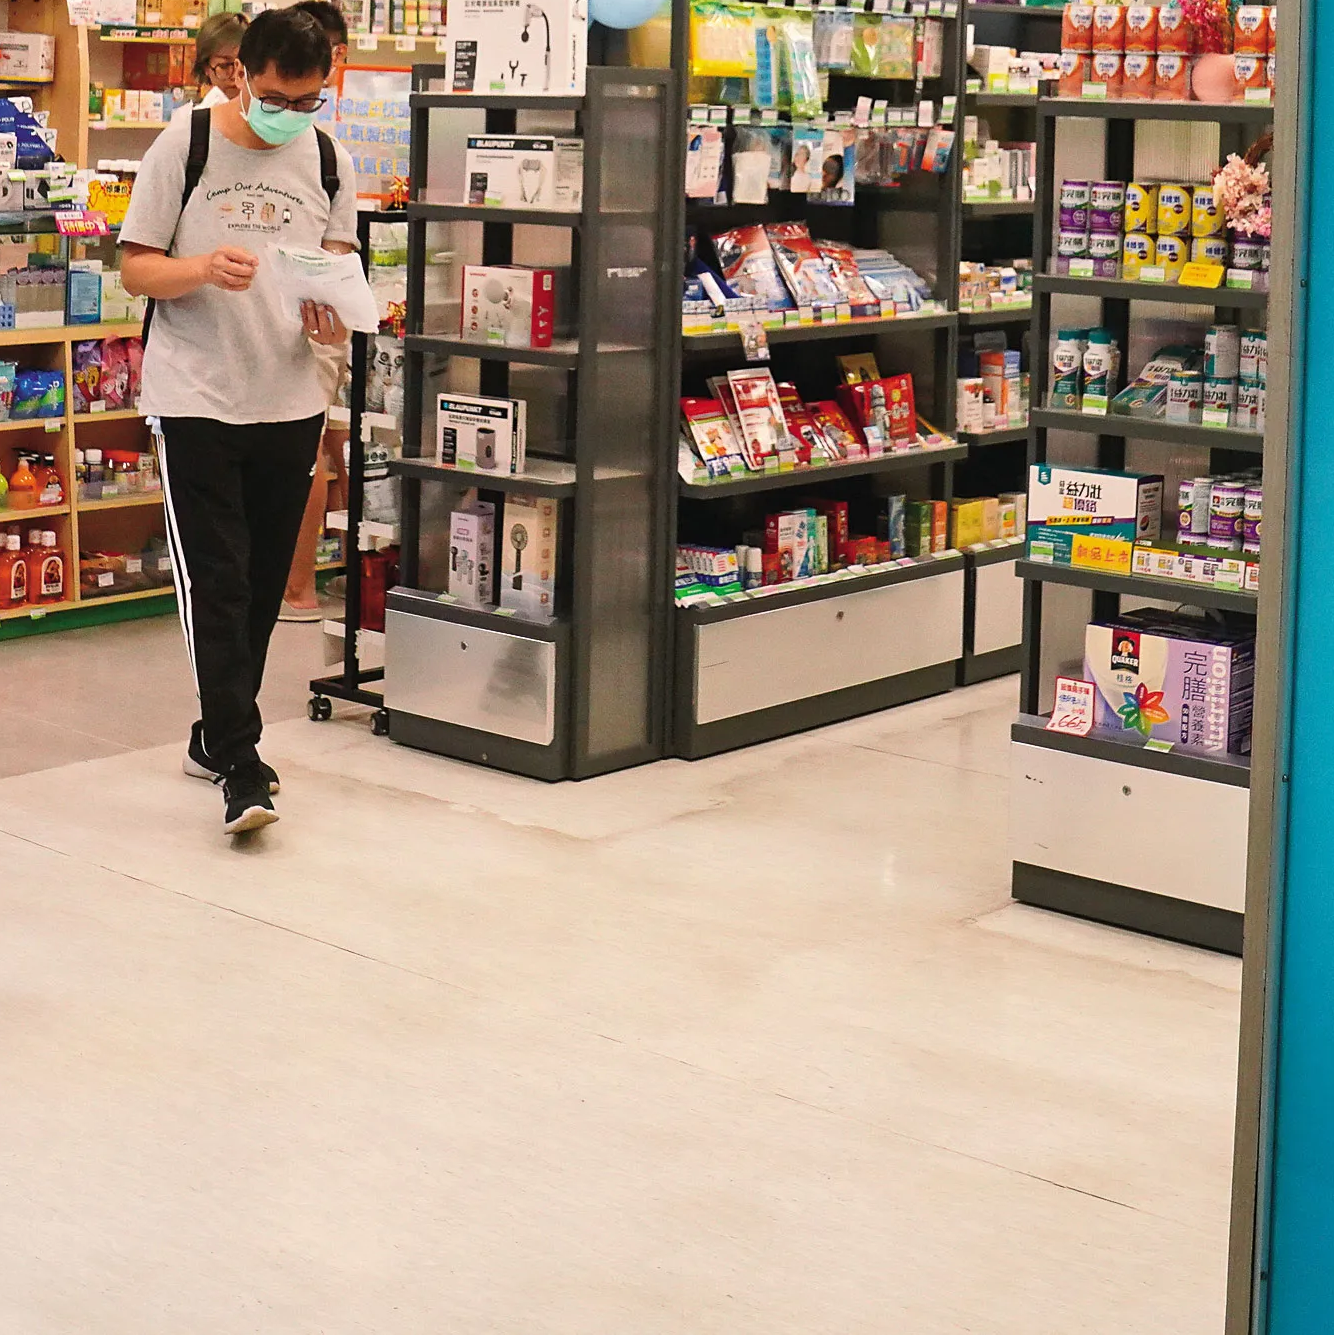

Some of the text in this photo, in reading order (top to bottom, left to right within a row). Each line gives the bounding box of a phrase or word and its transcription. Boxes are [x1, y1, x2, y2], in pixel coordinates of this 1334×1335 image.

[475, 139, 516, 149] BLAUPUNKT
[206, 182, 305, 206] Camp Out Adventures
[1112, 655, 1140, 667] QUAKER
